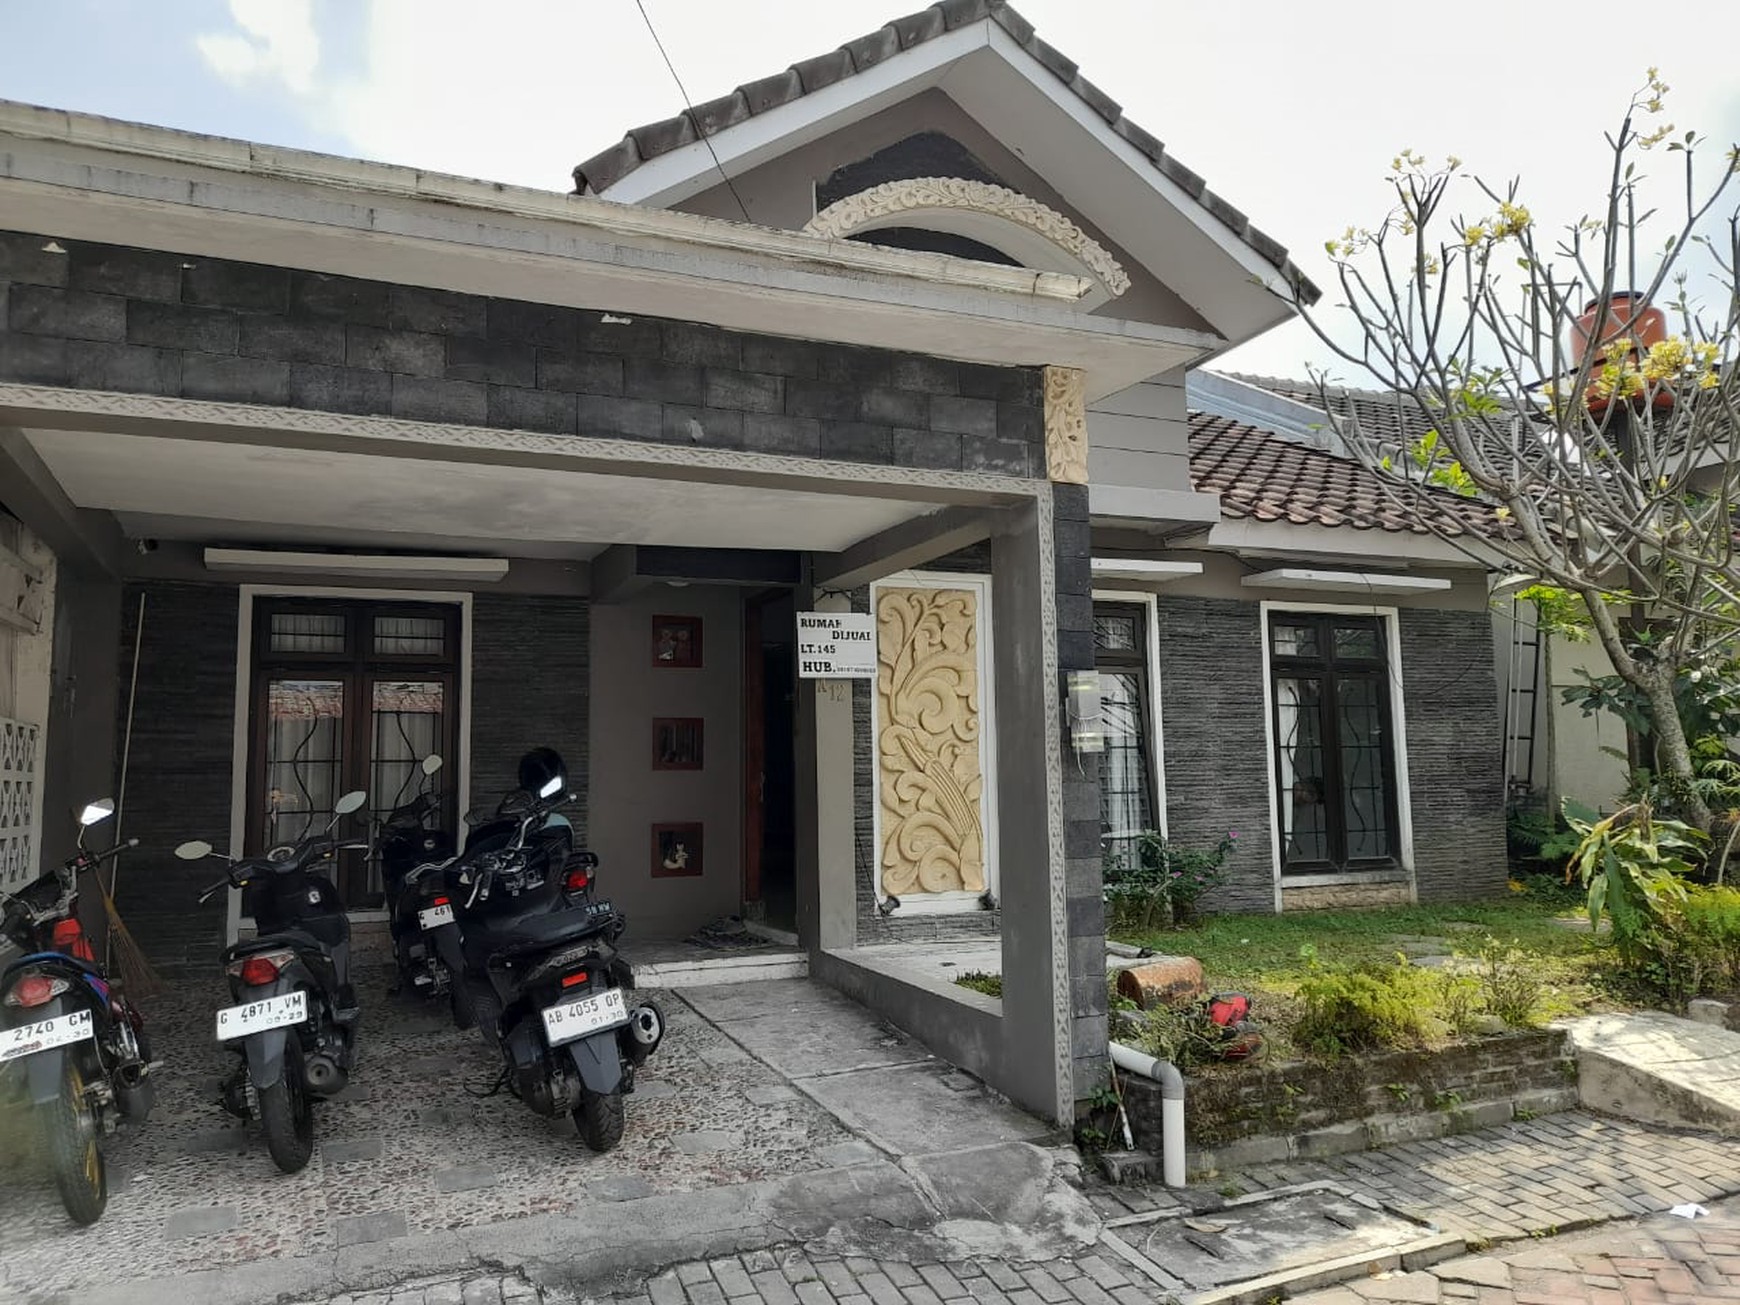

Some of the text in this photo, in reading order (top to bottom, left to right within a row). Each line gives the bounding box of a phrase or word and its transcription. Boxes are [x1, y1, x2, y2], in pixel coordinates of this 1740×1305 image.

[802, 661, 836, 673] HUB.
[548, 1010, 563, 1025] AB
[569, 999, 599, 1018] 4055
[14, 1011, 91, 1041] 2740 GM
